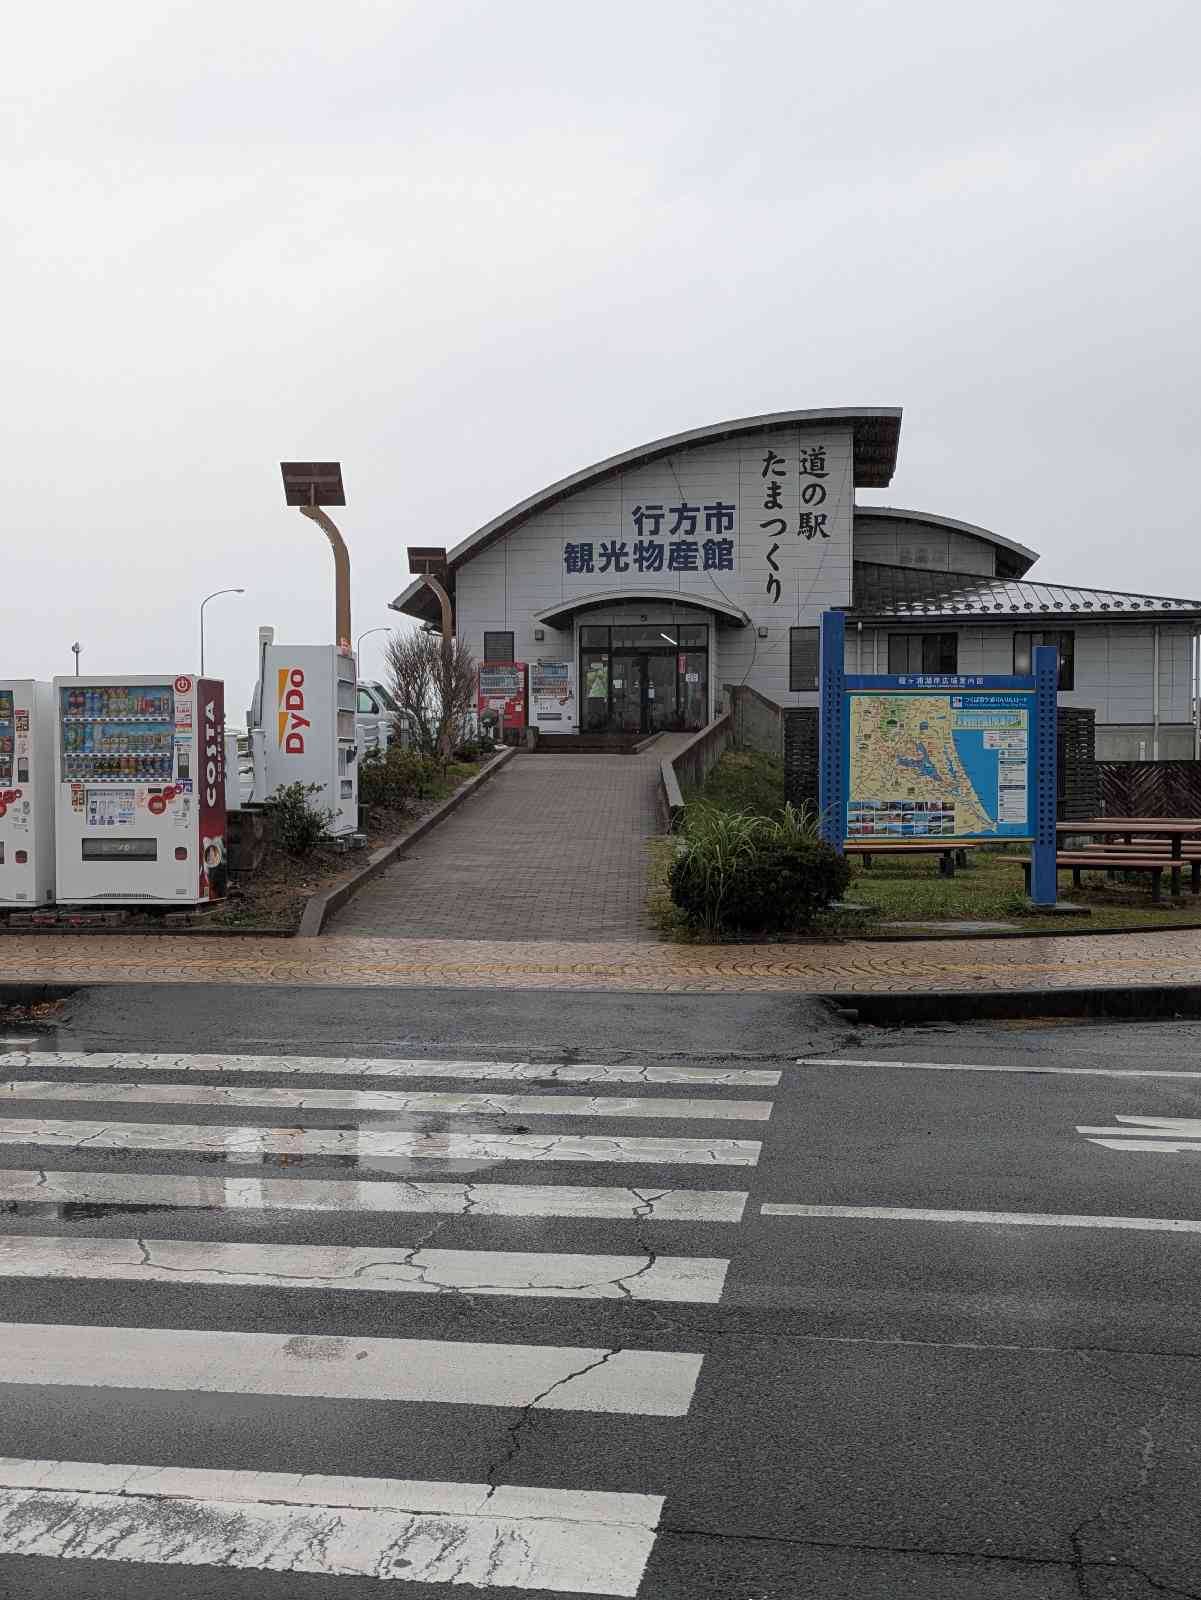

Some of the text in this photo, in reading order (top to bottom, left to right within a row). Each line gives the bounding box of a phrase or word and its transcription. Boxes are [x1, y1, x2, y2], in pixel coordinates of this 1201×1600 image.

[631, 501, 736, 536] 行方市
[760, 450, 788, 603] たまつくり
[797, 446, 831, 540] 道の駅
[564, 538, 735, 574] 観光物産館
[205, 700, 217, 807] COSTA
[285, 668, 311, 754] DyDo
